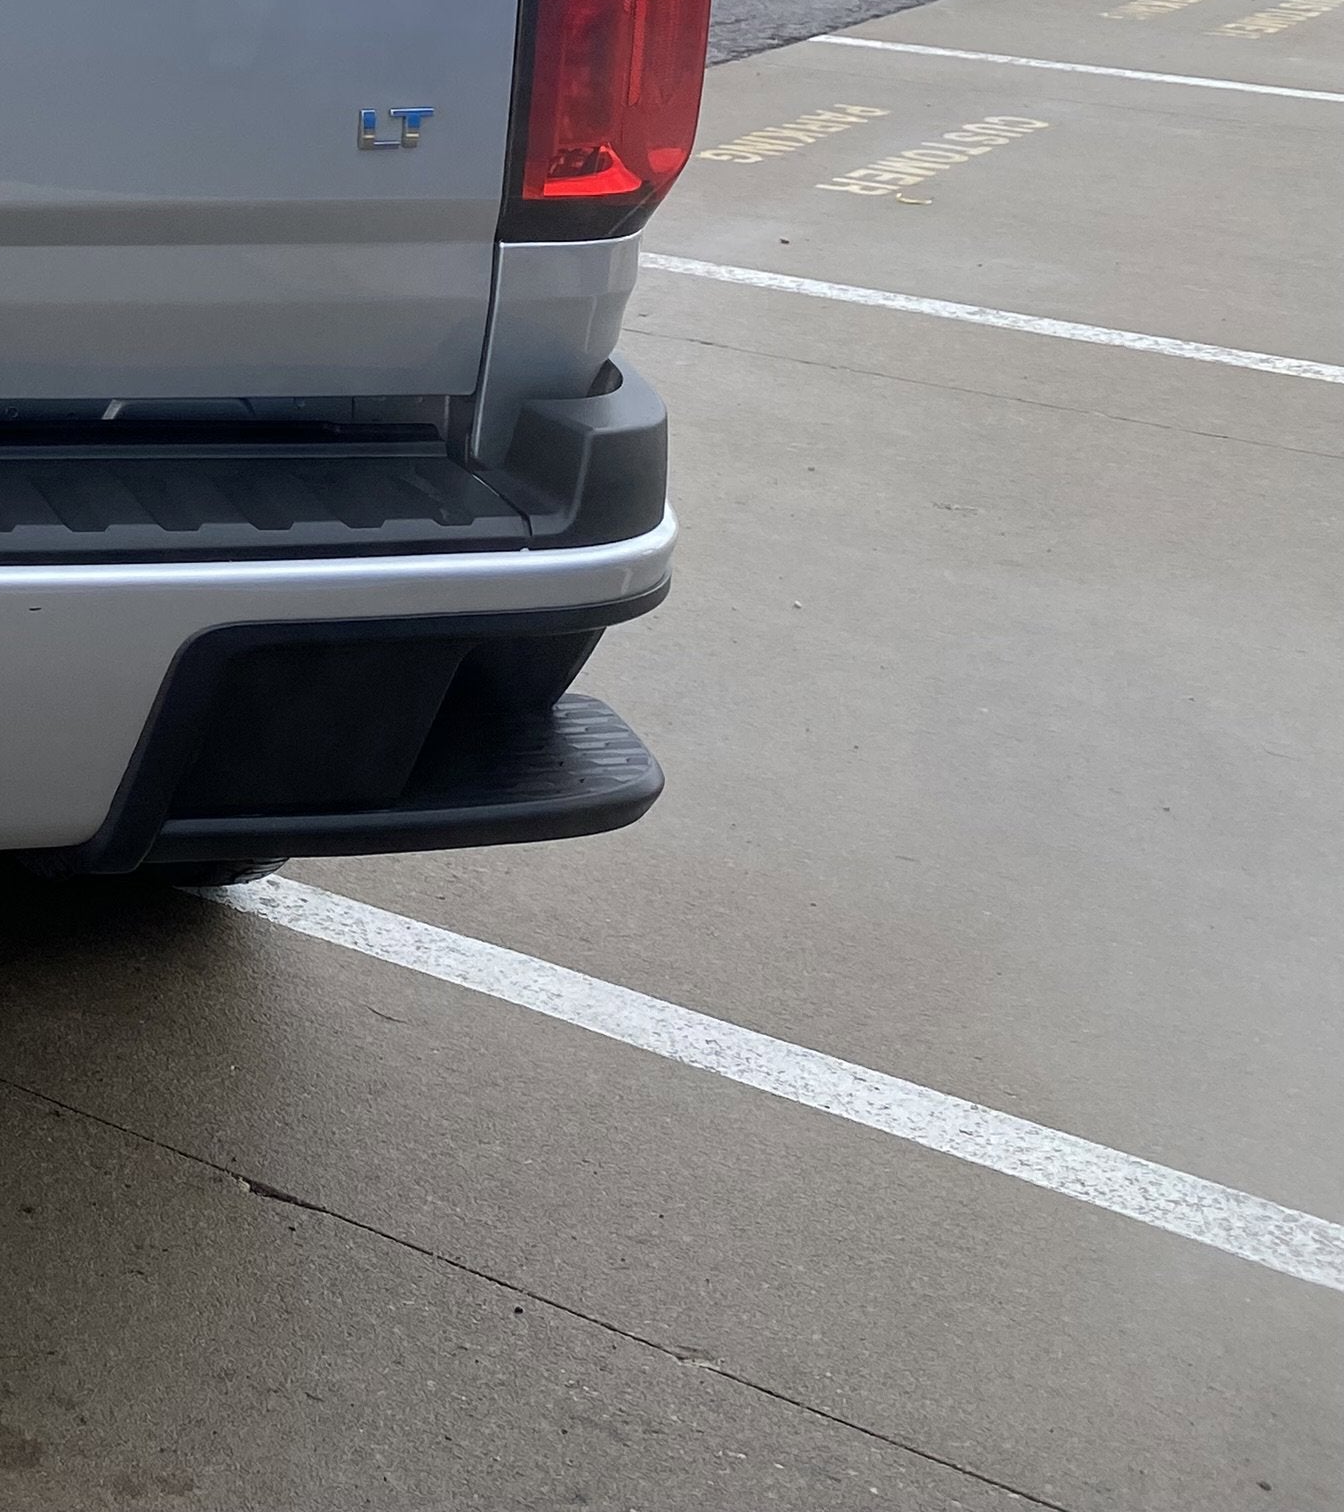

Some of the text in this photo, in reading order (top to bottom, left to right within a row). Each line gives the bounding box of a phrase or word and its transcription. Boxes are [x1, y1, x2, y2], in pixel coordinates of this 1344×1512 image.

[357, 107, 435, 150] LT
[698, 104, 890, 163] PARKING
[815, 115, 1049, 196] CUSTOMER
